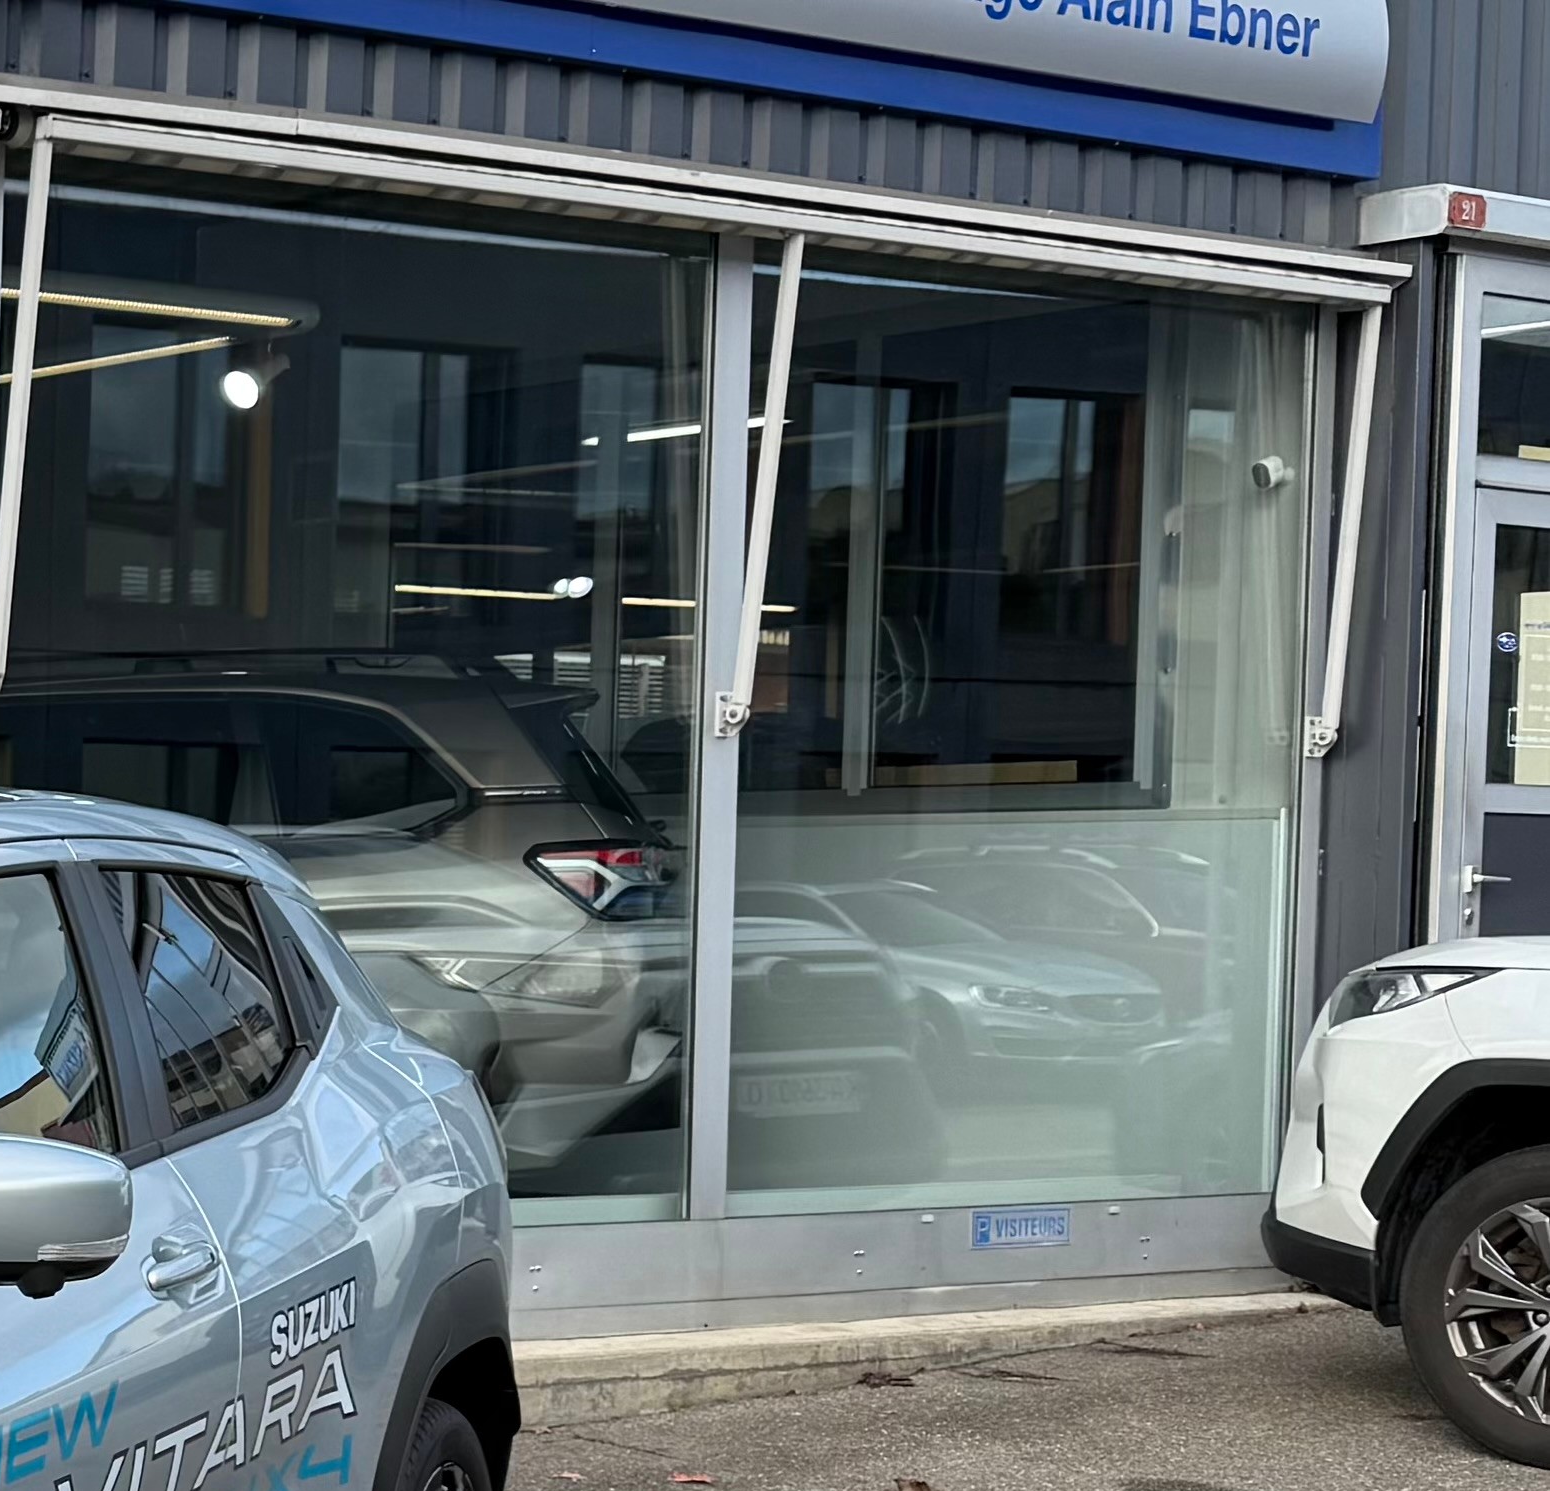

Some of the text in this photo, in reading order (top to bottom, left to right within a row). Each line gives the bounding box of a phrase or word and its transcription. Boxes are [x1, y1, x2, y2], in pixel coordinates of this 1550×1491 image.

[1188, 0, 1320, 58] Ebner
[1461, 200, 1476, 221] 21
[995, 1215, 1065, 1238] VISITEURS
[270, 1277, 357, 1369] SUZUKI
